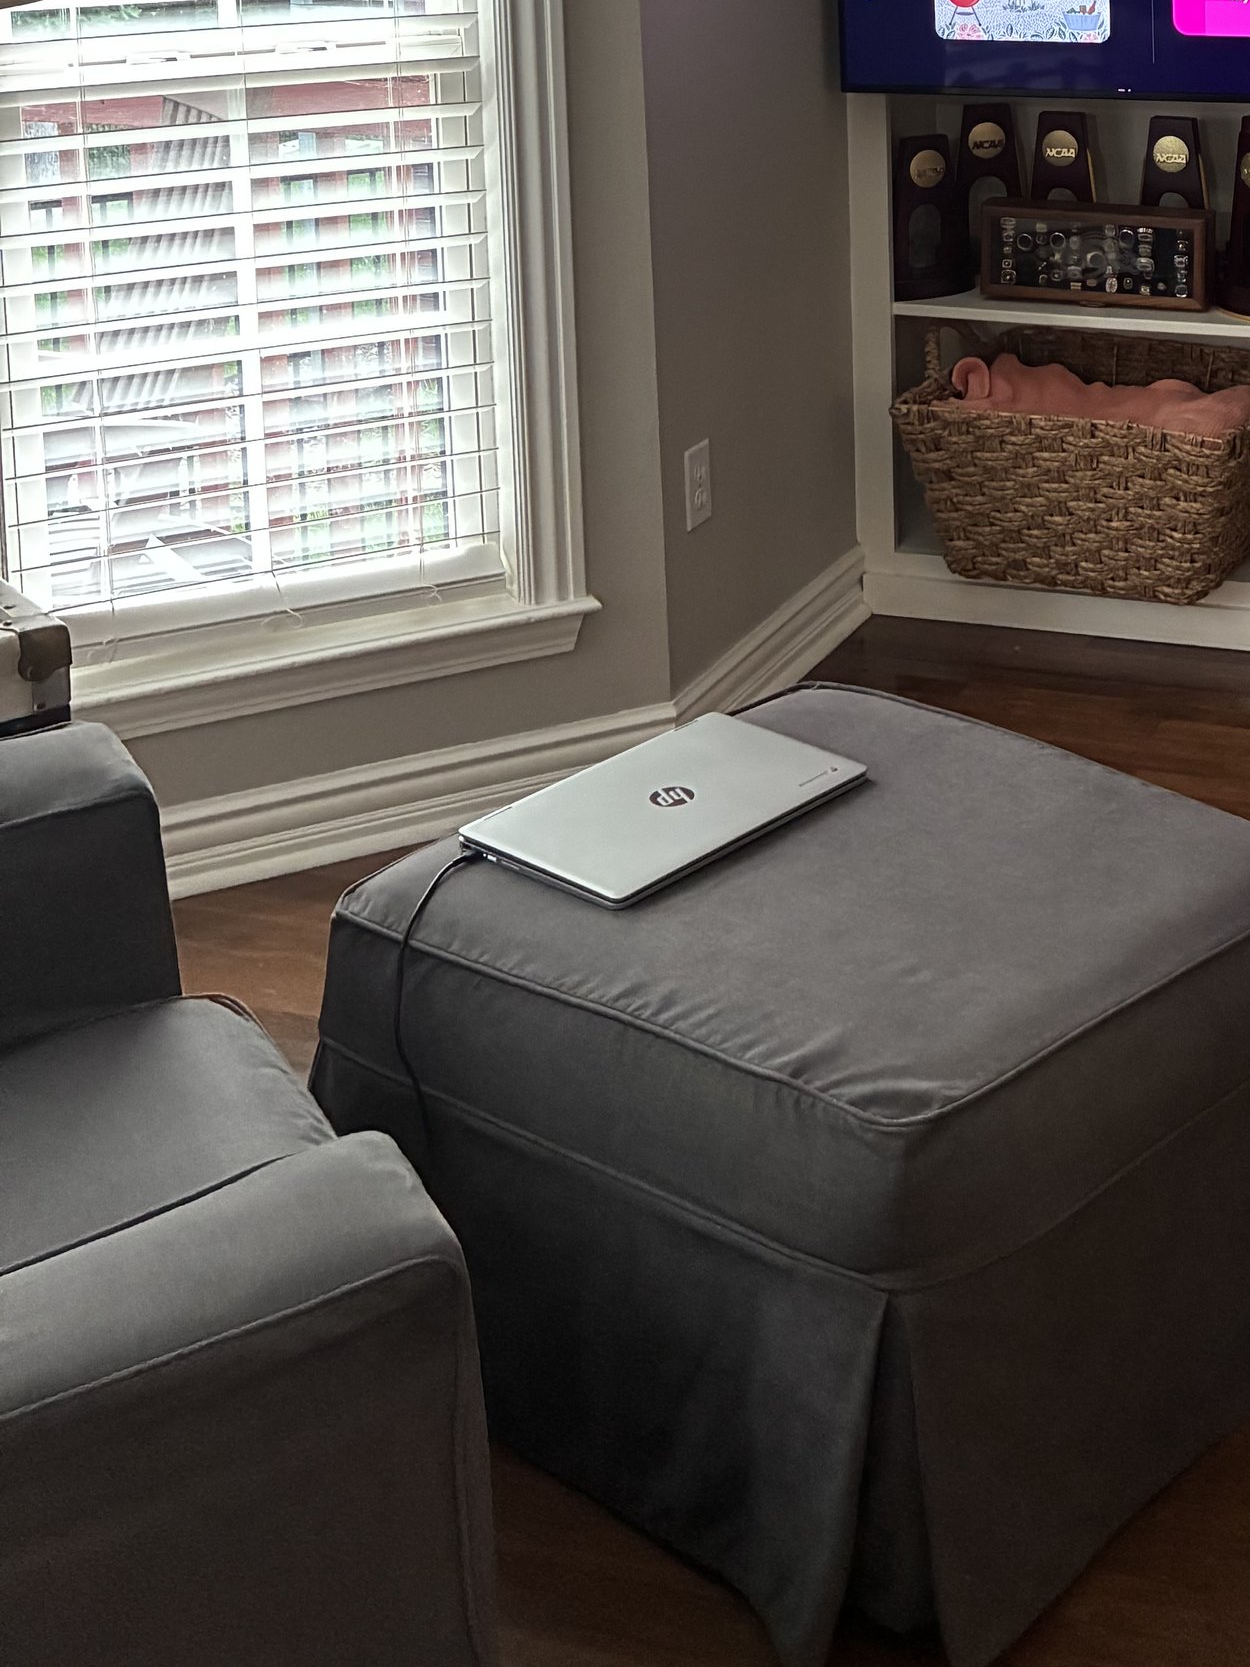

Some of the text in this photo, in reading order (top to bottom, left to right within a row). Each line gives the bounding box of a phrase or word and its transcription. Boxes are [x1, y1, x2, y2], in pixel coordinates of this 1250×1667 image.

[1045, 147, 1077, 158] NCAA
[1154, 153, 1188, 164] NCAA
[650, 786, 695, 807] hp
